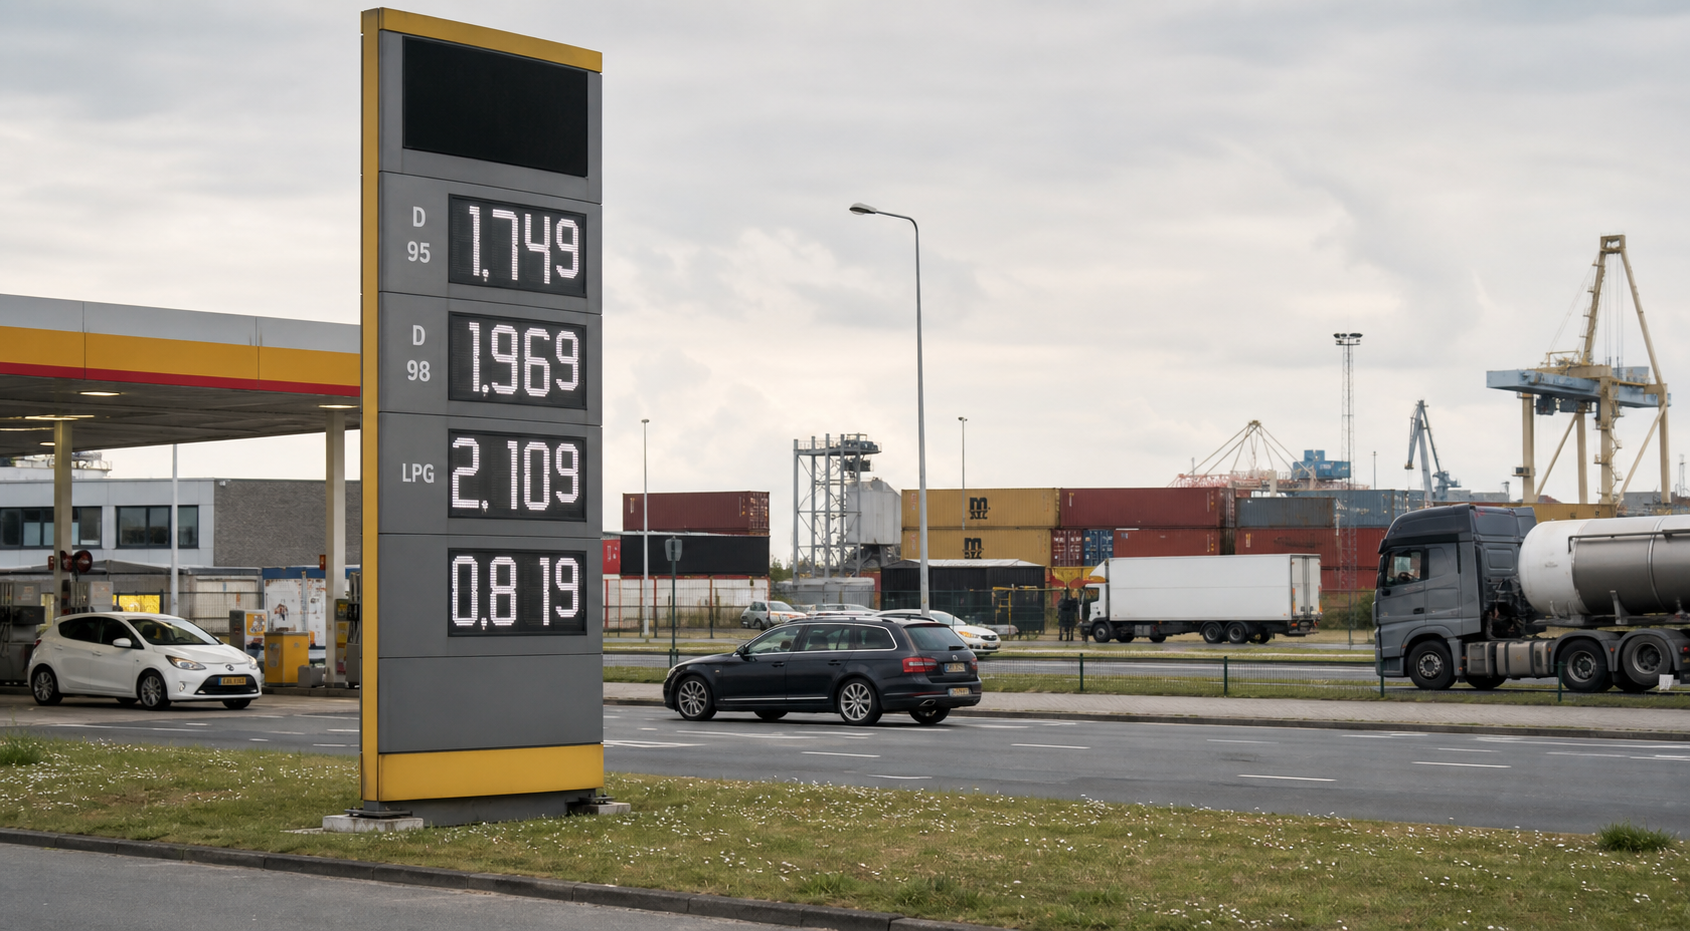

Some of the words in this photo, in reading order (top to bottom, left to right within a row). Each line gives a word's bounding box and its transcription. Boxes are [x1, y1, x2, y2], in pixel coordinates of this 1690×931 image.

[412, 206, 426, 228] D
[407, 241, 431, 264] 95
[469, 206, 579, 284] 1.749
[412, 325, 426, 346] D
[407, 360, 431, 382] 98
[469, 322, 579, 397] 1.969
[402, 463, 435, 484] LPG
[452, 437, 579, 512] 2.109
[452, 555, 579, 630] 0.819
